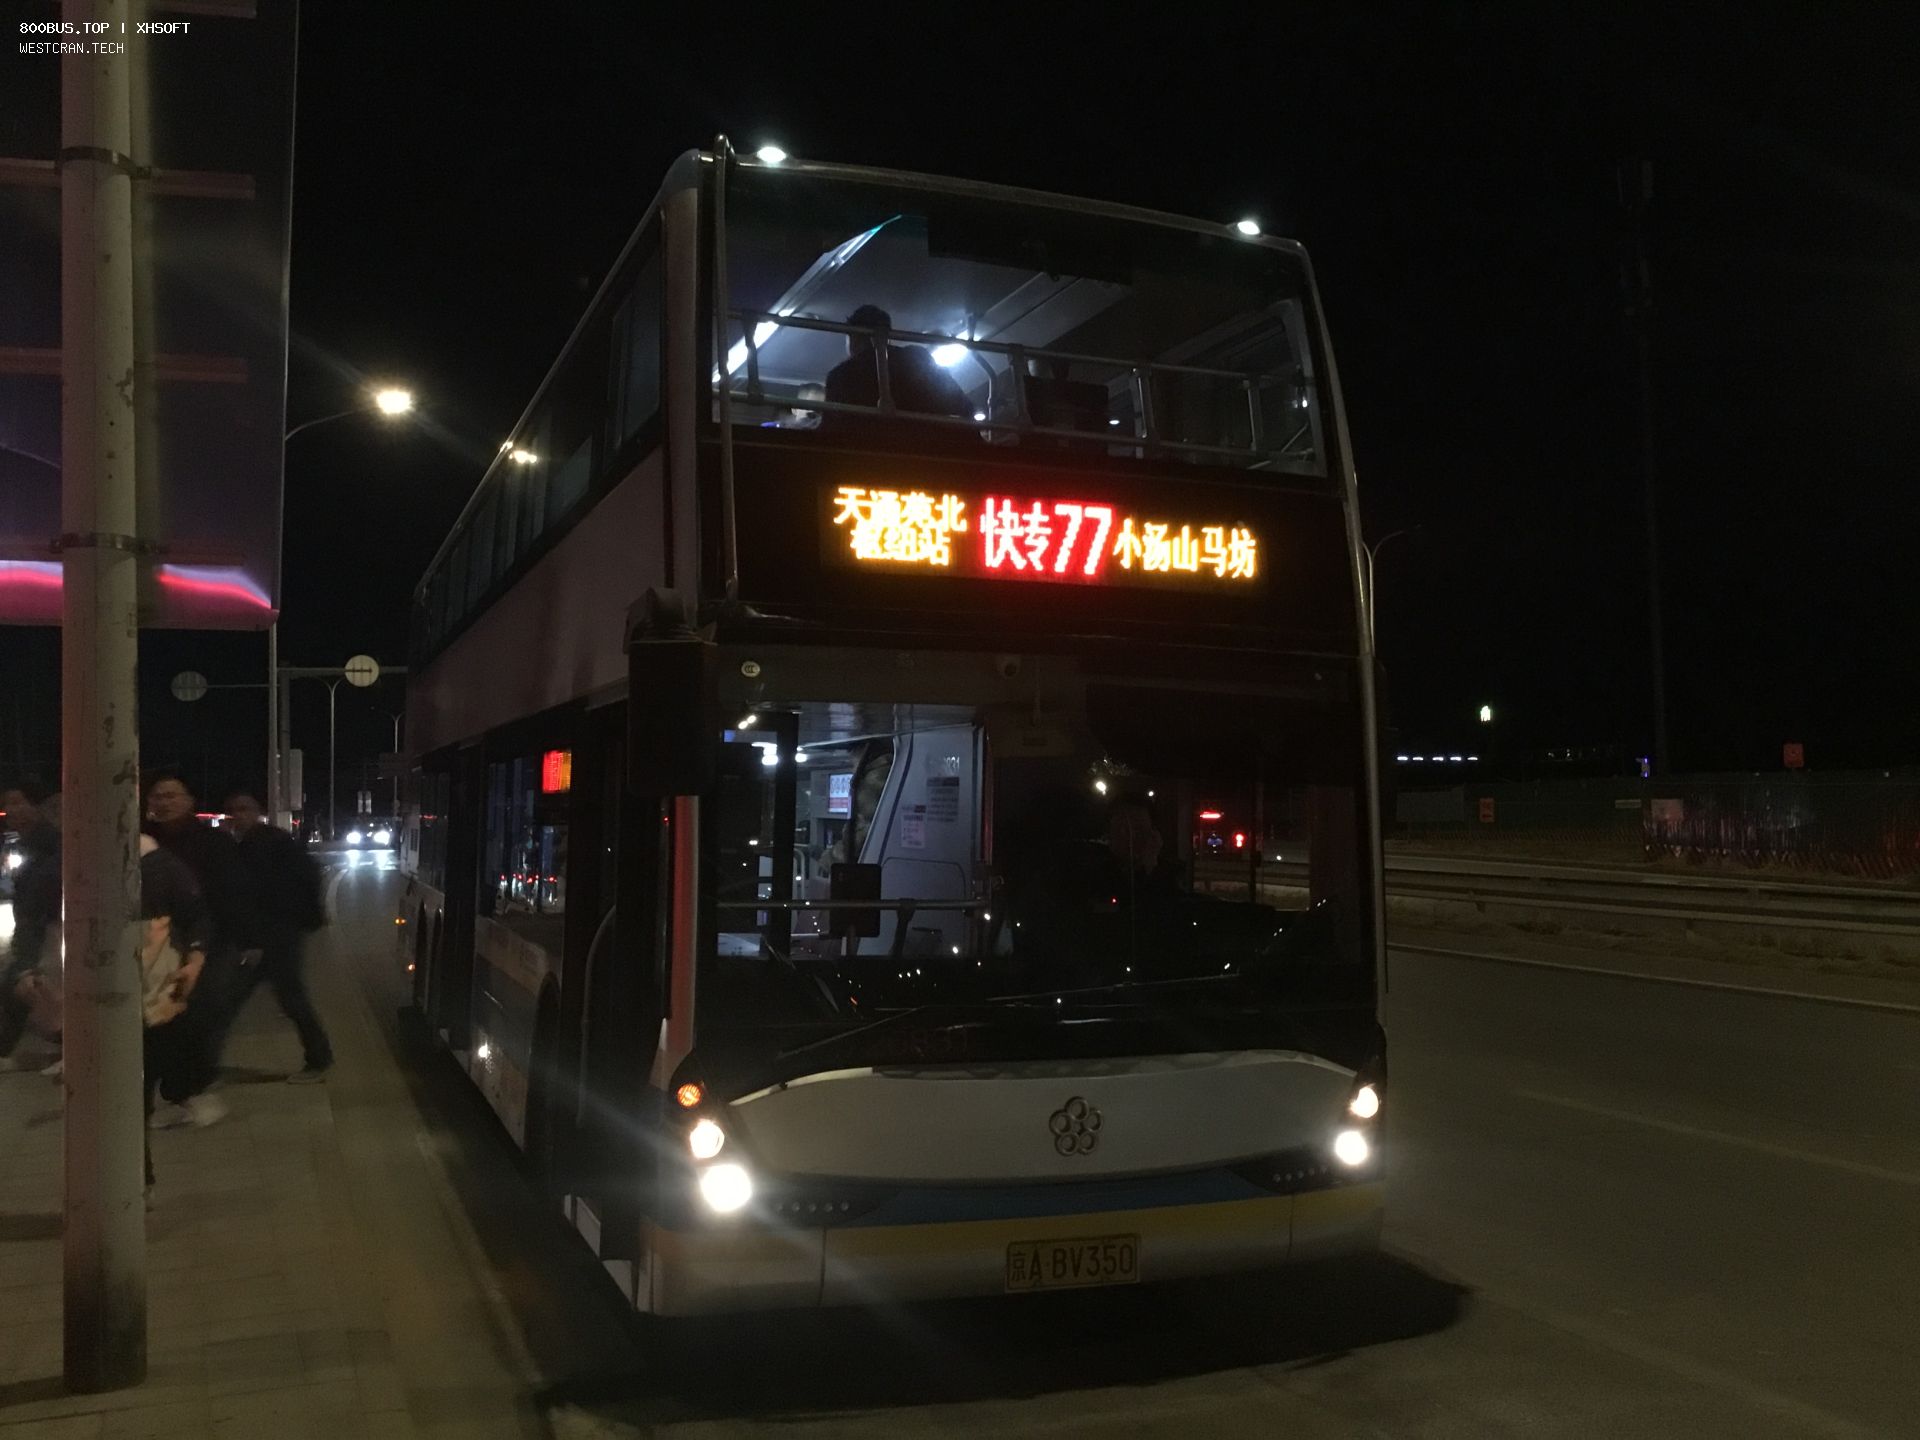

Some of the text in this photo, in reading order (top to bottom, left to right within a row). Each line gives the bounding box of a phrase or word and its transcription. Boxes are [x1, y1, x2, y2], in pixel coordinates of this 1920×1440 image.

[1114, 517, 1258, 580] 小汤山马坊
